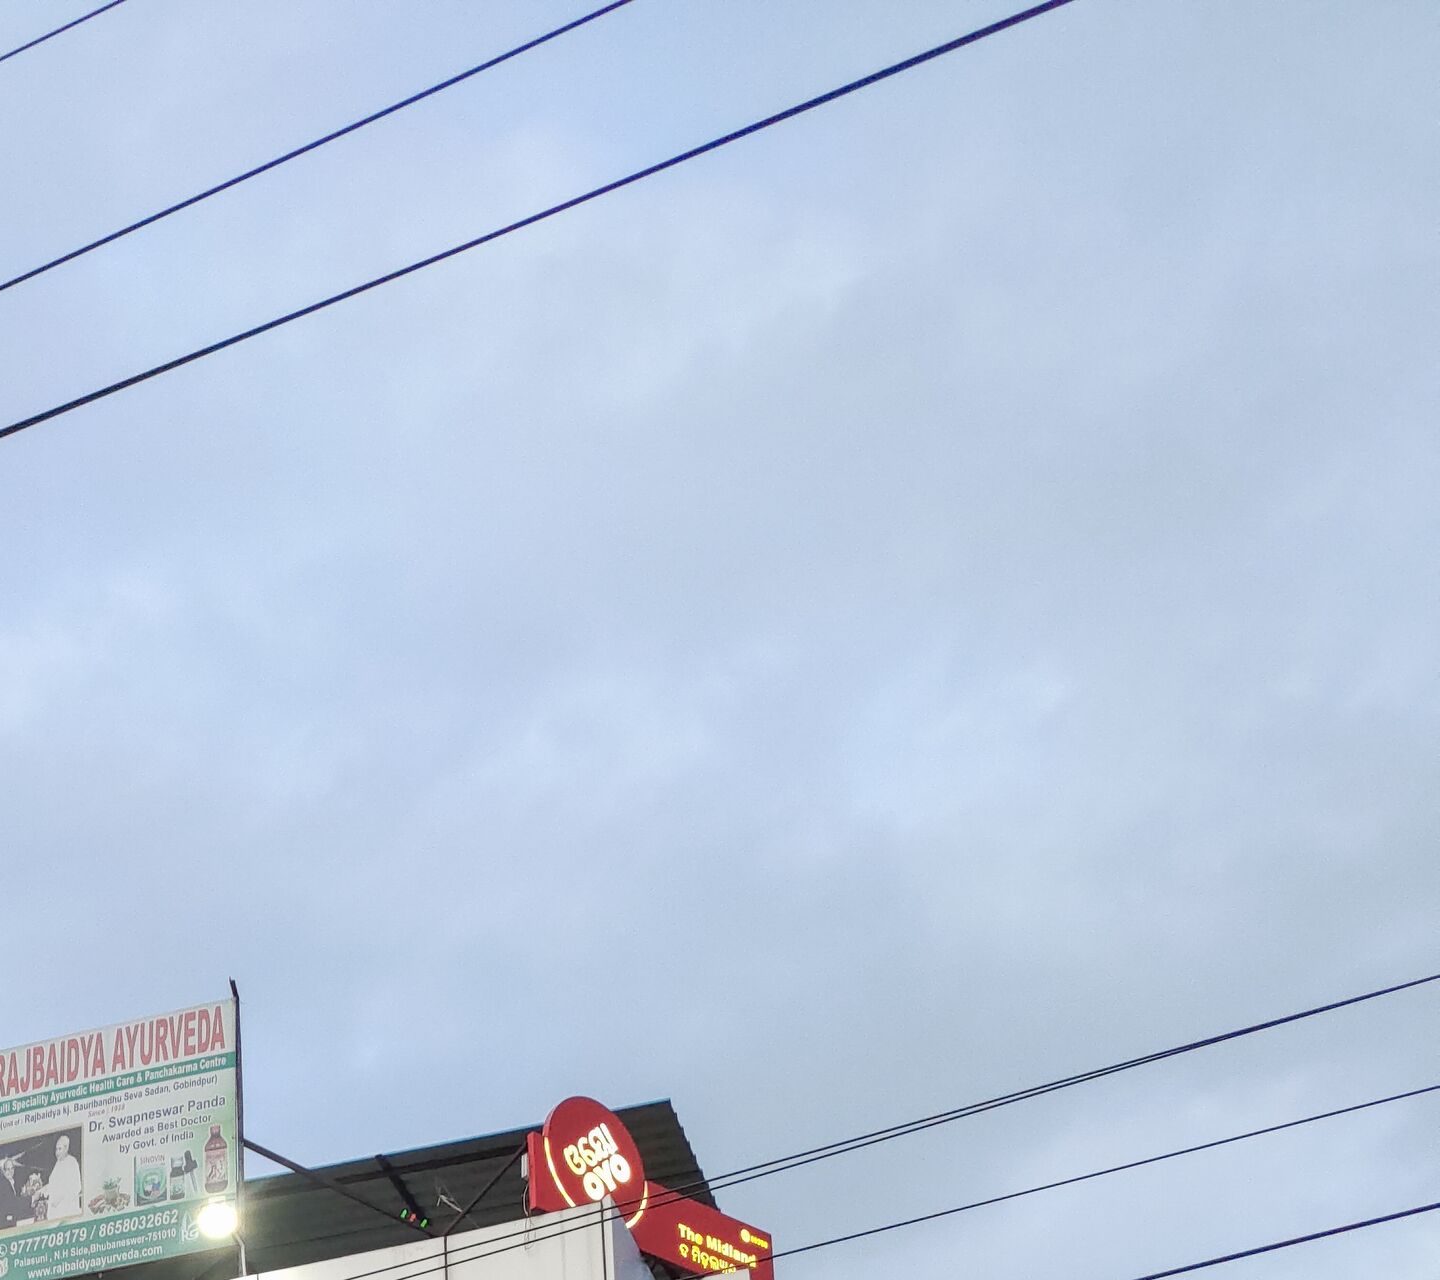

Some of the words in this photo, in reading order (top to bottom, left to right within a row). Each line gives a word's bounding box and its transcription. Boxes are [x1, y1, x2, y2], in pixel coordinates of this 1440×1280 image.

[111, 1005, 226, 1073] AYURVEDA
[11, 1094, 49, 1113] Speciality
[50, 1086, 88, 1104] Ayurvedic
[89, 1077, 115, 1095] Health
[116, 1075, 135, 1088] Care
[136, 1072, 143, 1083] &
[144, 1062, 198, 1082] Panchakarma
[199, 1056, 227, 1070] Centre
[24, 1109, 61, 1125] Rajbaidya
[173, 1074, 218, 1091] Gobindpur)
[89, 1120, 105, 1133] Dr.
[108, 1104, 185, 1128] Swapneswar
[187, 1095, 226, 1112] Panda
[101, 1126, 142, 1144] Awarded
[143, 1124, 154, 1134] as
[157, 1119, 178, 1131] Best
[180, 1113, 212, 1127] Doctor
[119, 1143, 130, 1154] by
[132, 1138, 157, 1151] Govt.
[159, 1134, 169, 1145] of
[171, 1130, 194, 1143] India
[582, 1153, 631, 1201] OYO
[9, 1227, 87, 1256] 9777708179
[89, 1224, 96, 1240] /
[98, 1209, 178, 1237] 8658032662
[677, 1222, 704, 1246] The
[705, 1234, 757, 1268] Midland
[27, 1244, 164, 1279] www.rajbaidyaayurveda.com
